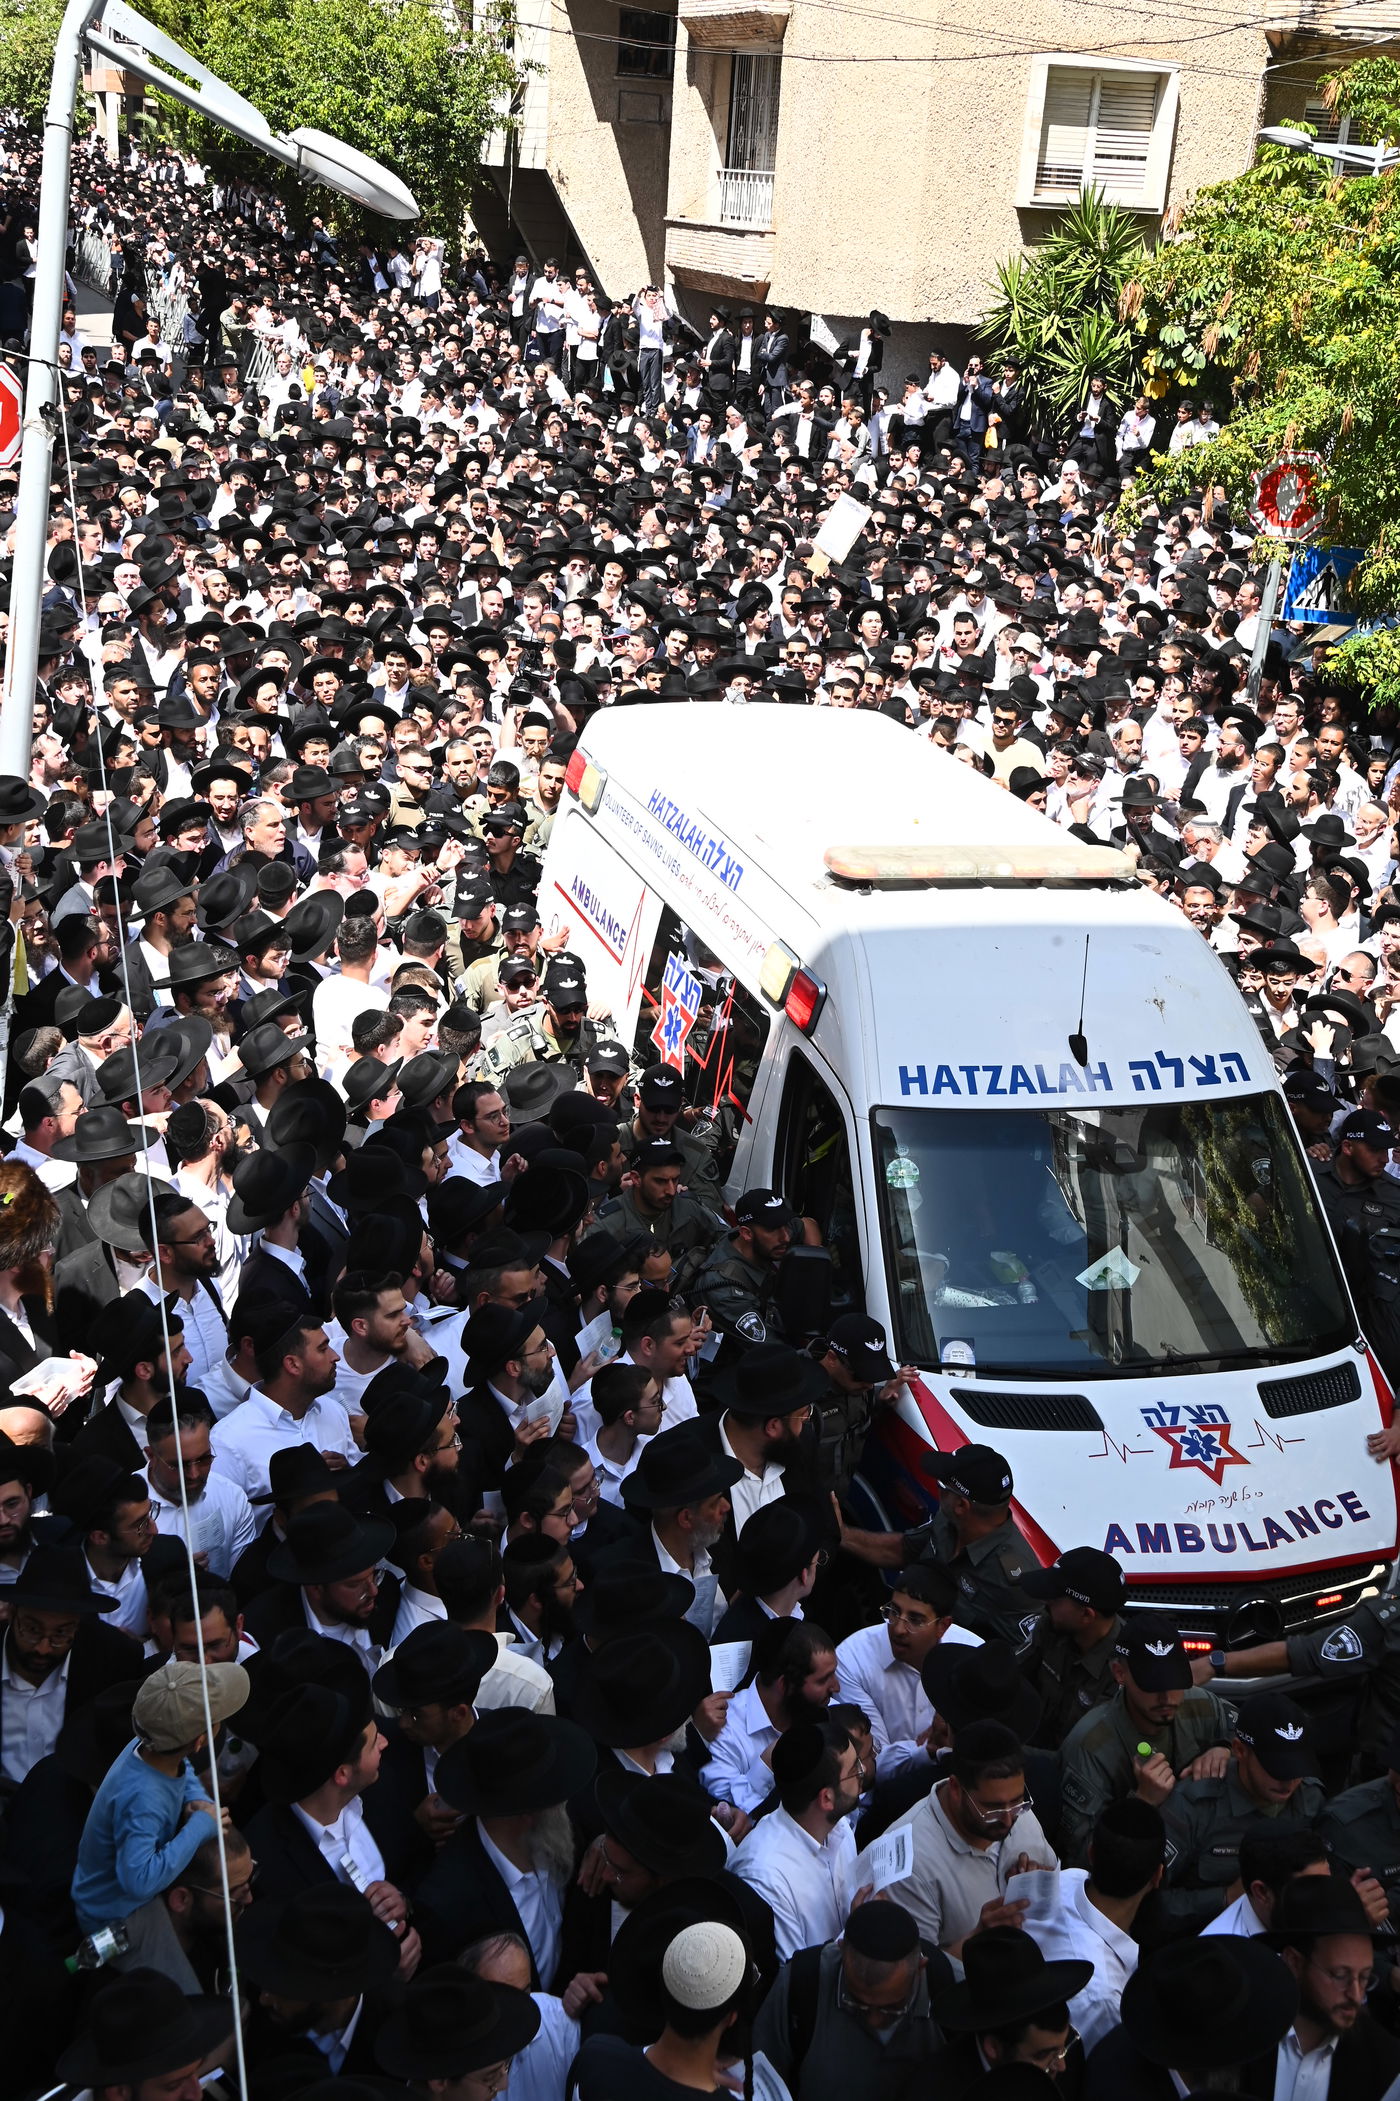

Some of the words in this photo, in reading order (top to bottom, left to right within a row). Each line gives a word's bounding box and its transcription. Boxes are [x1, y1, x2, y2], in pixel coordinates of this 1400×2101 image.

[633, 821, 644, 834] OF
[661, 853, 681, 877] LIVES
[648, 788, 706, 856] HATZALAH
[702, 839, 744, 892] הצלה
[571, 875, 627, 951] AMBULANCE
[663, 954, 701, 1016] הצלה
[898, 1061, 1114, 1097] HATZALAH
[1128, 1050, 1252, 1092] הצלה
[829, 1340, 849, 1356] POLICE
[1140, 1401, 1230, 1428] הצלה
[1184, 1499, 1216, 1514] קובעת
[1218, 1491, 1239, 1510] שניה
[1241, 1485, 1251, 1501] כל
[1254, 1490, 1264, 1498] כי
[1103, 1490, 1372, 1554] AMBULANCE
[1065, 1587, 1091, 1604] משטרה
